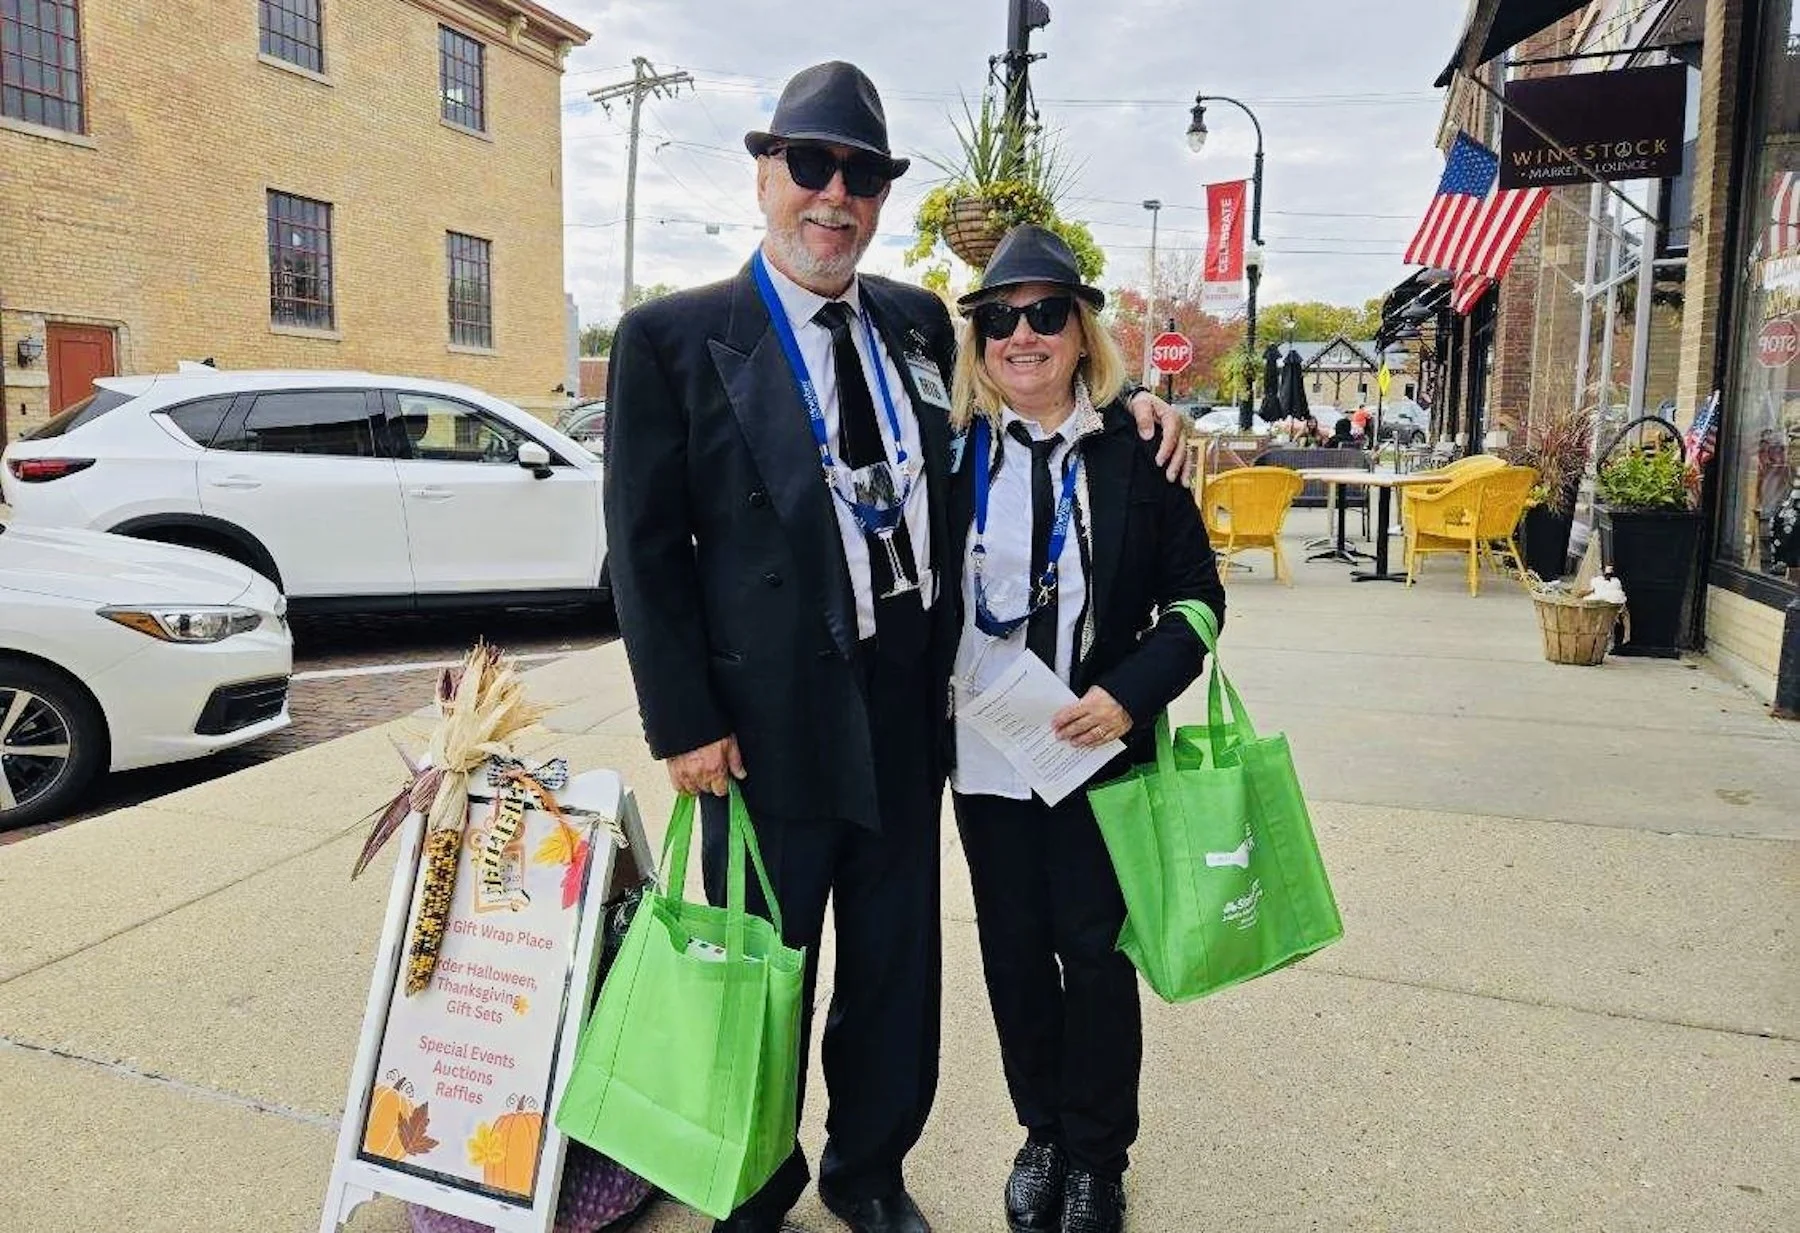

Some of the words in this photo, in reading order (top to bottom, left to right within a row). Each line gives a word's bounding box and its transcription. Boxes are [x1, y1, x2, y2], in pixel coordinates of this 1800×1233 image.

[1512, 139, 1668, 166] WINESTOCK
[1218, 197, 1232, 274] CELEBRATE
[1153, 345, 1188, 361] STOP
[453, 919, 478, 938] Gift
[481, 923, 514, 946] Wrap
[517, 931, 554, 950] Place
[466, 961, 537, 992] Halloween,
[446, 999, 471, 1017] Gift
[474, 1005, 503, 1024] Sets
[419, 1035, 468, 1059] Special
[470, 1045, 516, 1069] Events
[432, 1059, 493, 1087] Auctions
[434, 1081, 484, 1105] Raffles
